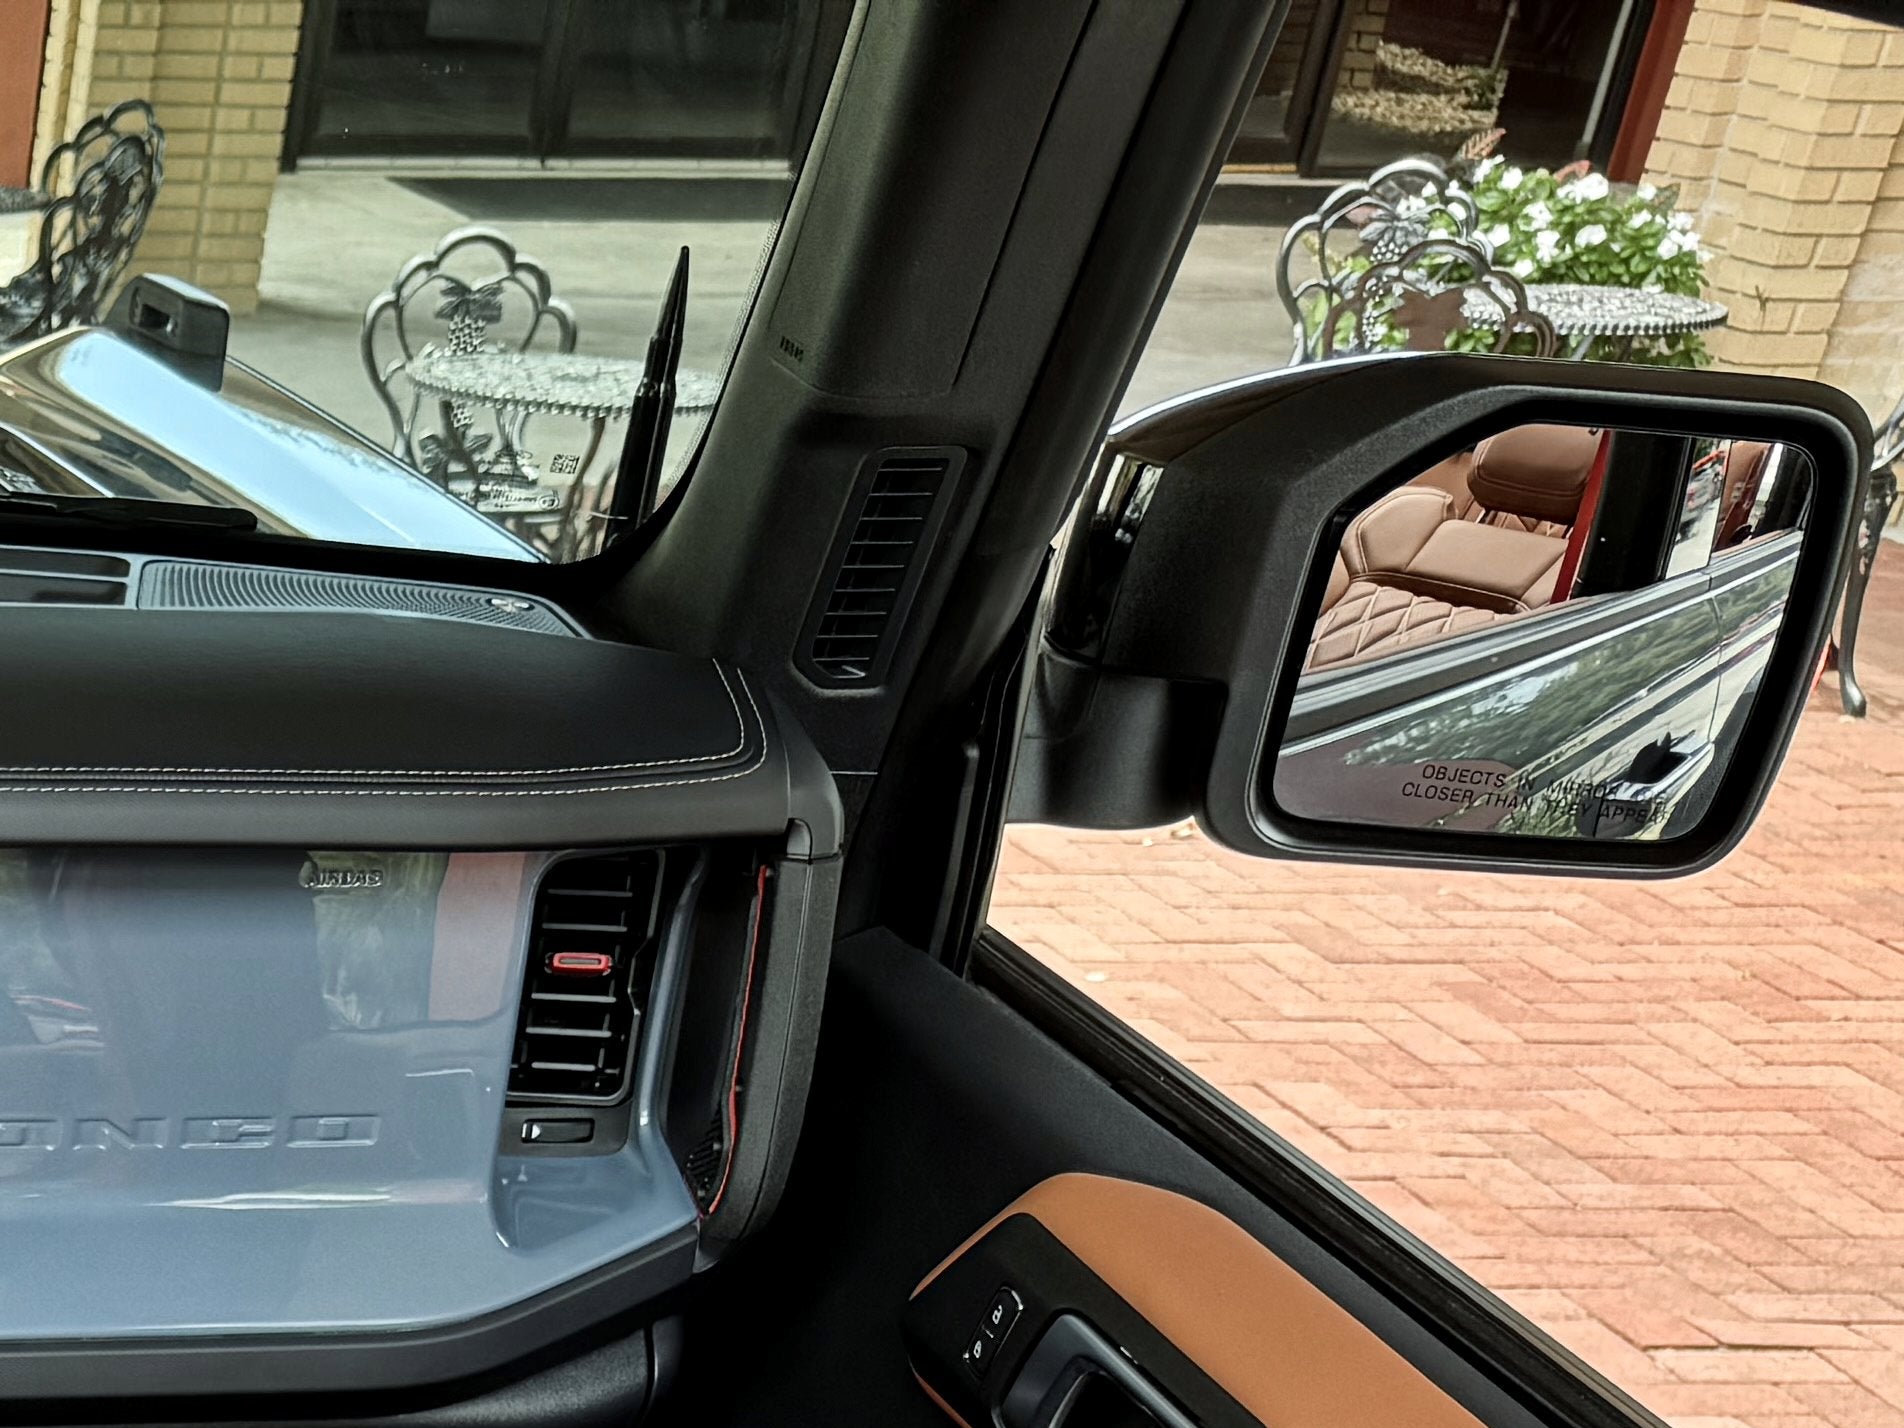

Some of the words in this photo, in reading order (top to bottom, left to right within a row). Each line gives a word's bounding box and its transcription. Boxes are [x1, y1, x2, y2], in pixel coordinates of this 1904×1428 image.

[1422, 764, 1506, 788] OBJECTS
[1401, 782, 1475, 802] CLOSER
[1484, 790, 1533, 812] THAN
